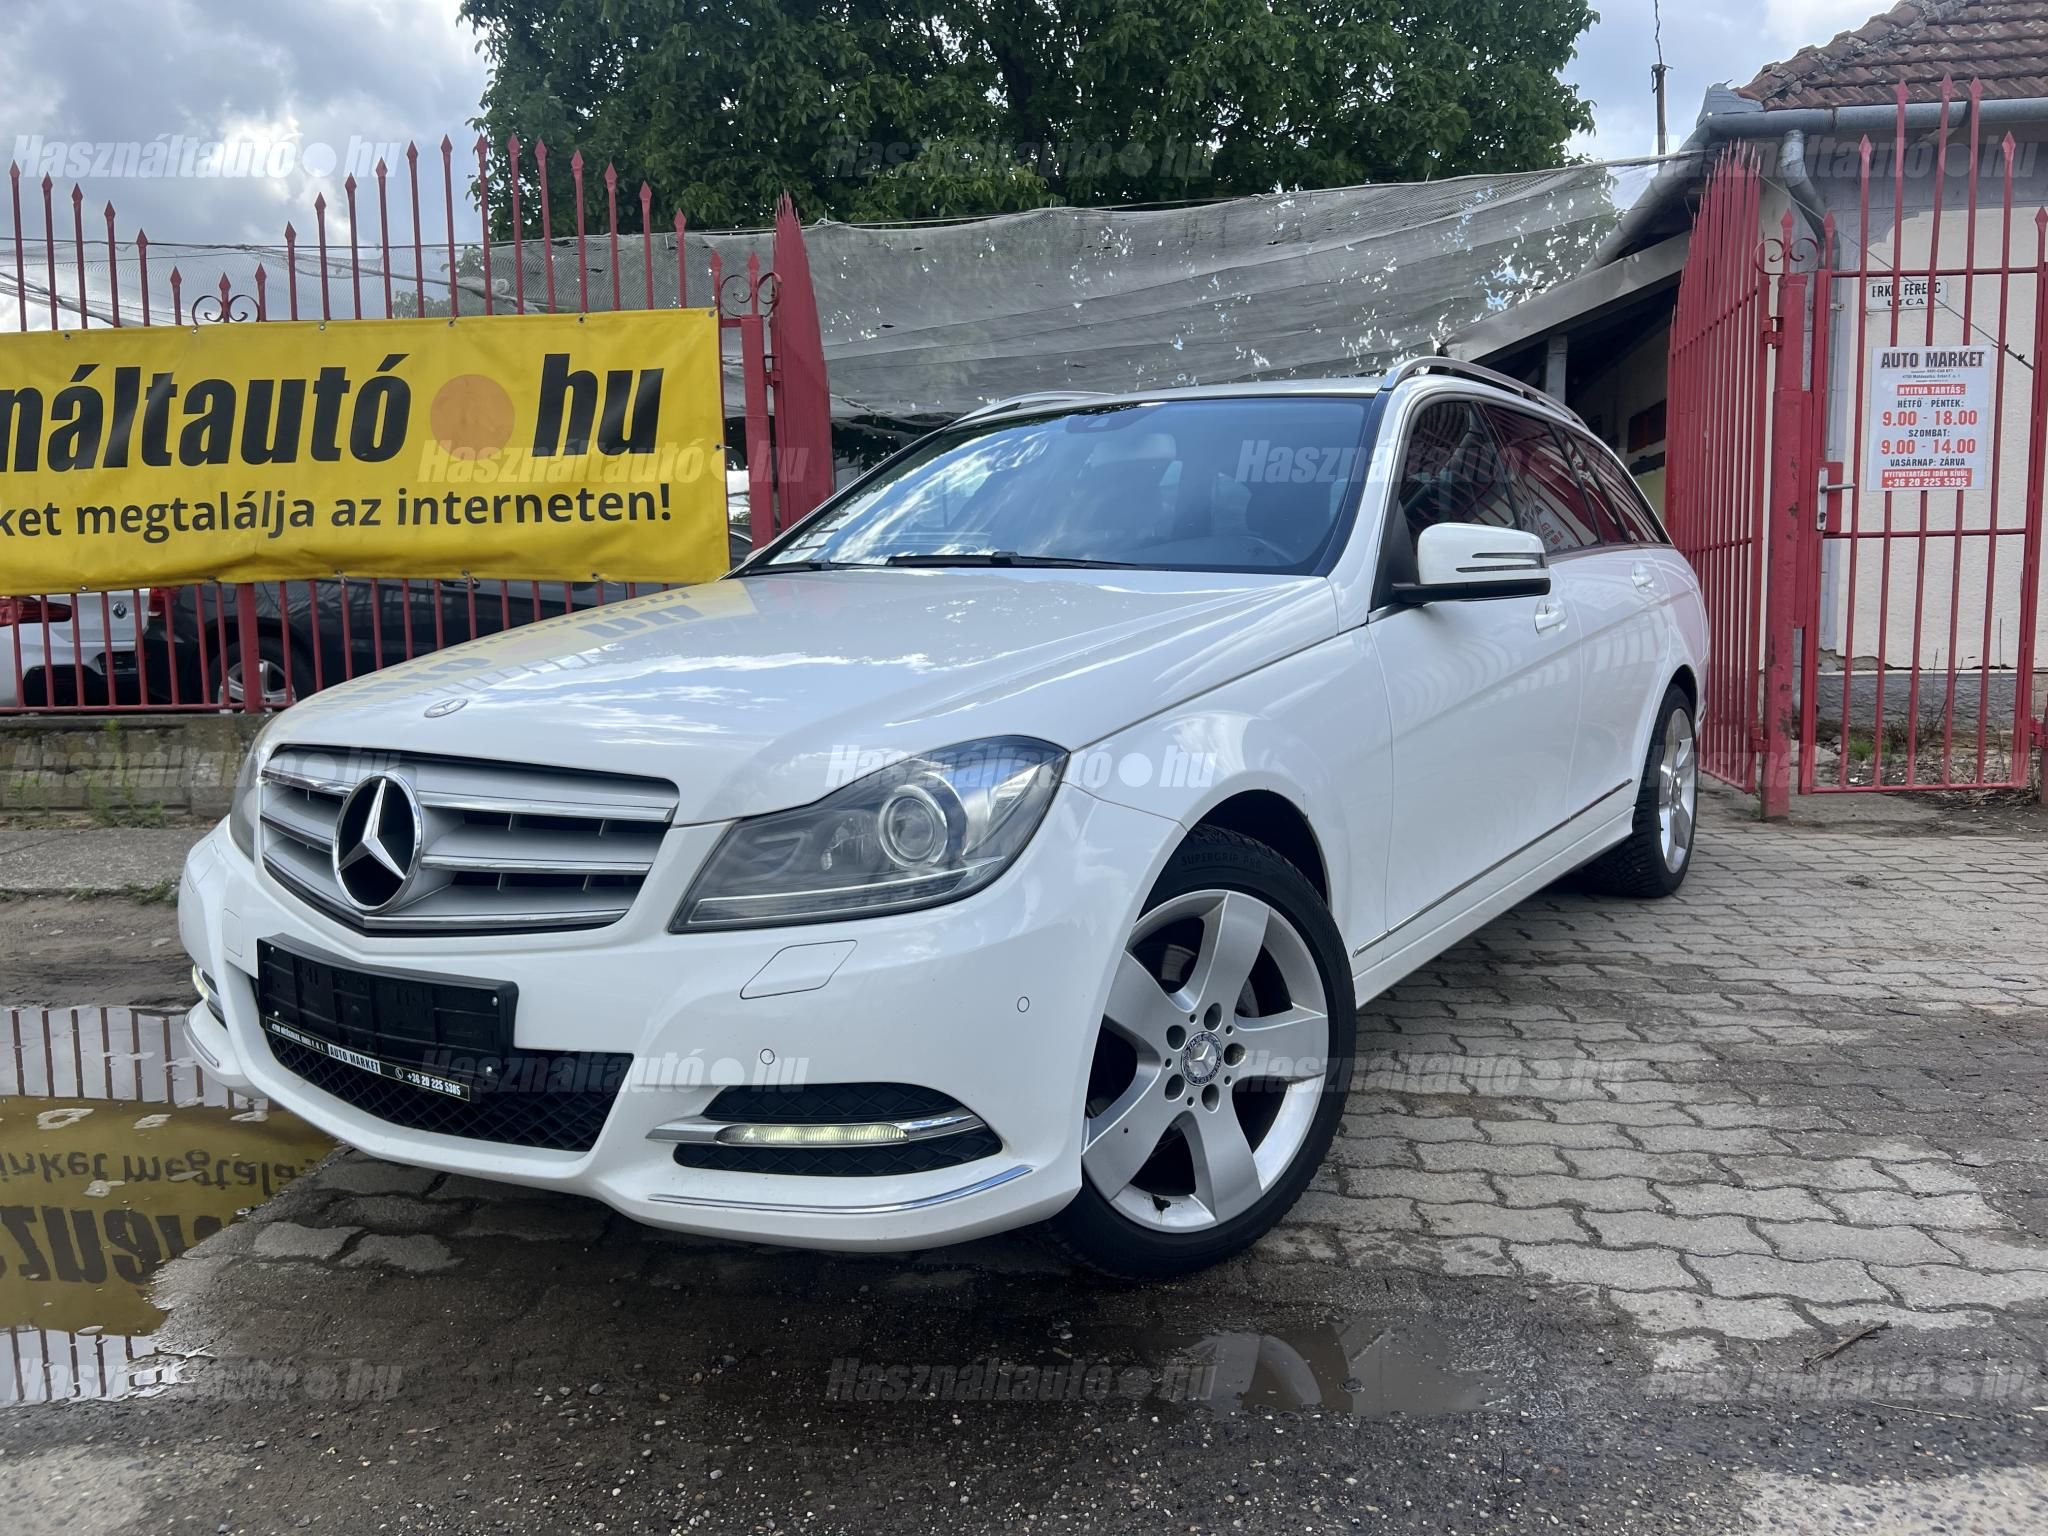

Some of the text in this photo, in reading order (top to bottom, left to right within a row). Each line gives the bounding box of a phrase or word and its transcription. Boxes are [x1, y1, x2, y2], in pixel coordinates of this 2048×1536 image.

[1904, 282, 1941, 296] FEREC
[1880, 351, 1985, 369] AUTO MARKET
[1899, 384, 1965, 396] NYITVA TARTÁS:
[1931, 397, 1965, 408] PÉNTEK:
[1882, 411, 1917, 426] 9.00
[1935, 410, 1978, 426] 18.00
[1908, 429, 1950, 438] SZOMBAT:
[1881, 439, 1916, 455] 9.00
[1933, 438, 1976, 454] 14.00
[1890, 456, 1965, 467] VASÁRNAP: ZÁRVA
[1887, 479, 1905, 487] +36
[1923, 478, 1943, 486] 225
[76, 490, 315, 544] megtalálja
[331, 498, 381, 527] az
[397, 483, 671, 526] interneten!
[329, 1045, 348, 1061] AUTO
[349, 1051, 379, 1071] MARKET
[407, 1072, 420, 1084] +36
[421, 1075, 430, 1087] 20
[431, 1078, 444, 1090] 225
